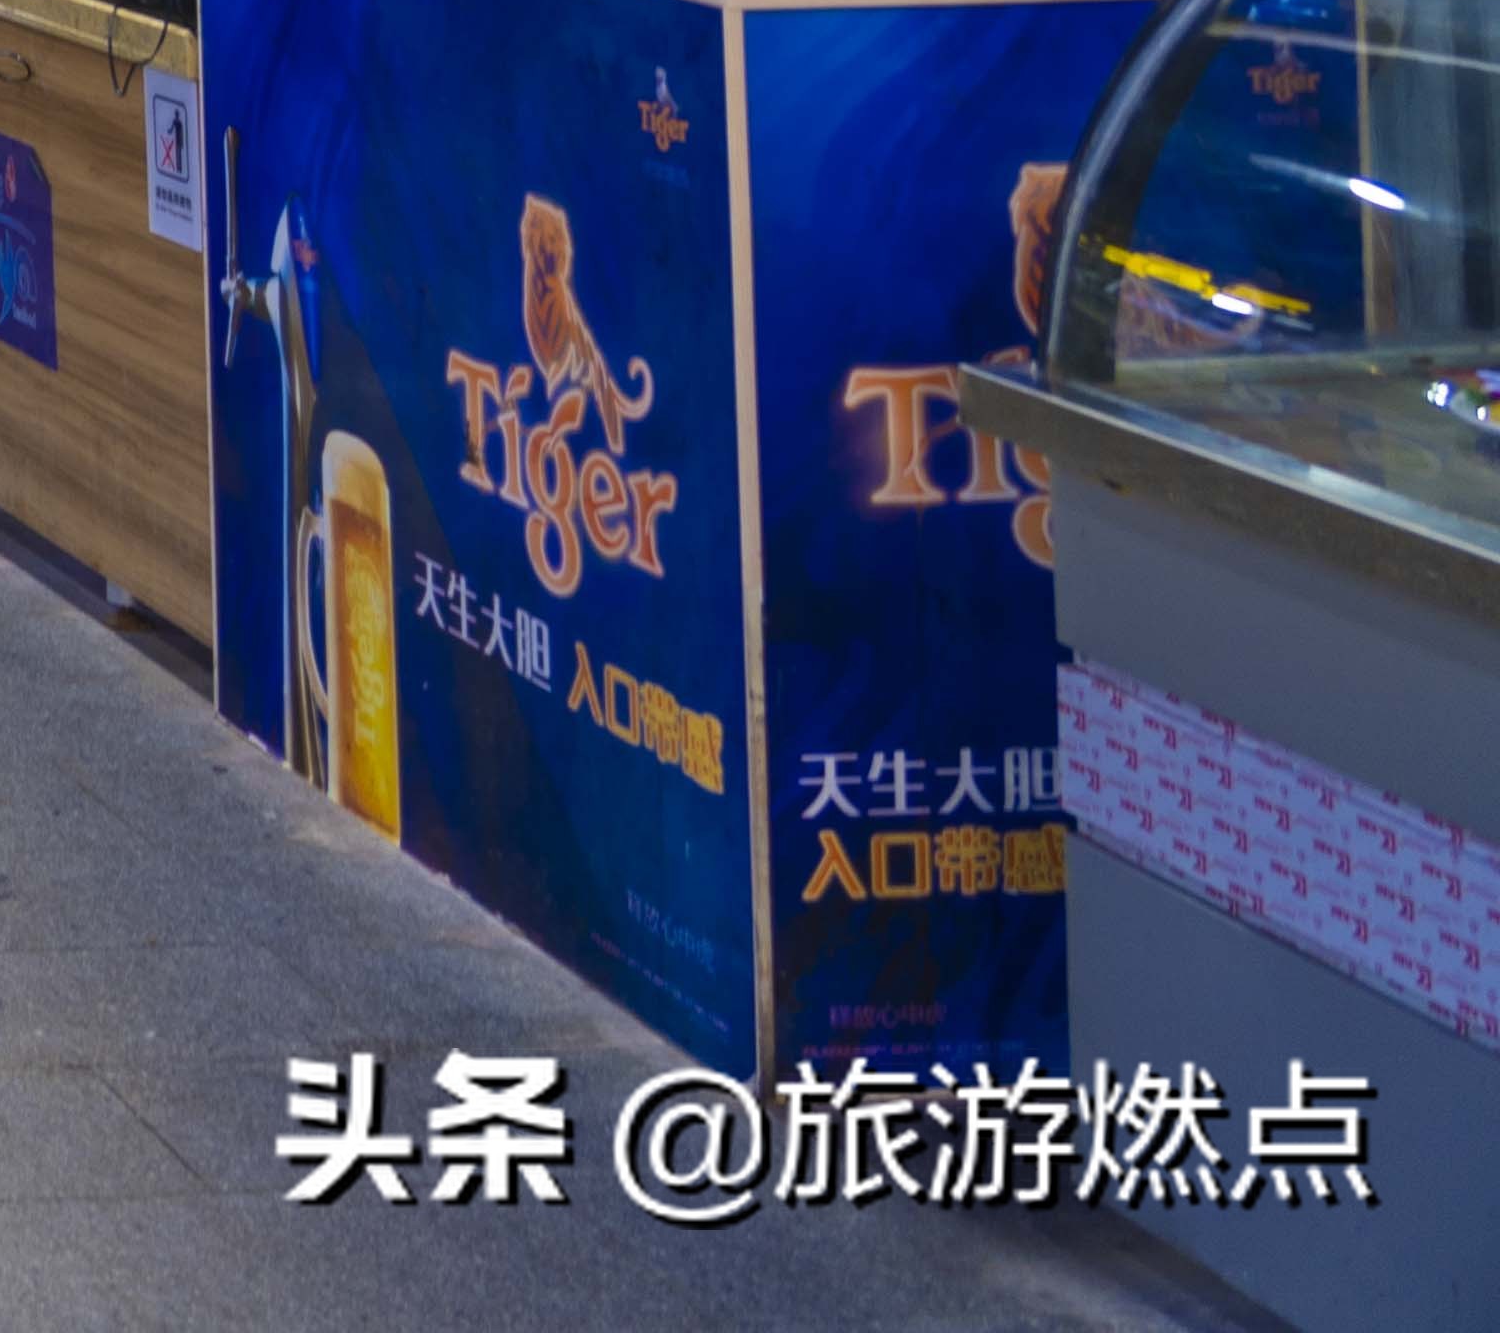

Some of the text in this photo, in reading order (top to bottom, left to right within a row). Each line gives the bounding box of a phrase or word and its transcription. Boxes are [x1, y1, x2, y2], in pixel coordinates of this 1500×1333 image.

[445, 348, 678, 599] Tiger
[412, 550, 553, 694] 天生大胆
[566, 641, 726, 796] 入口带感
[798, 746, 1063, 819] 天生大胆
[801, 824, 1072, 902] 入口带感
